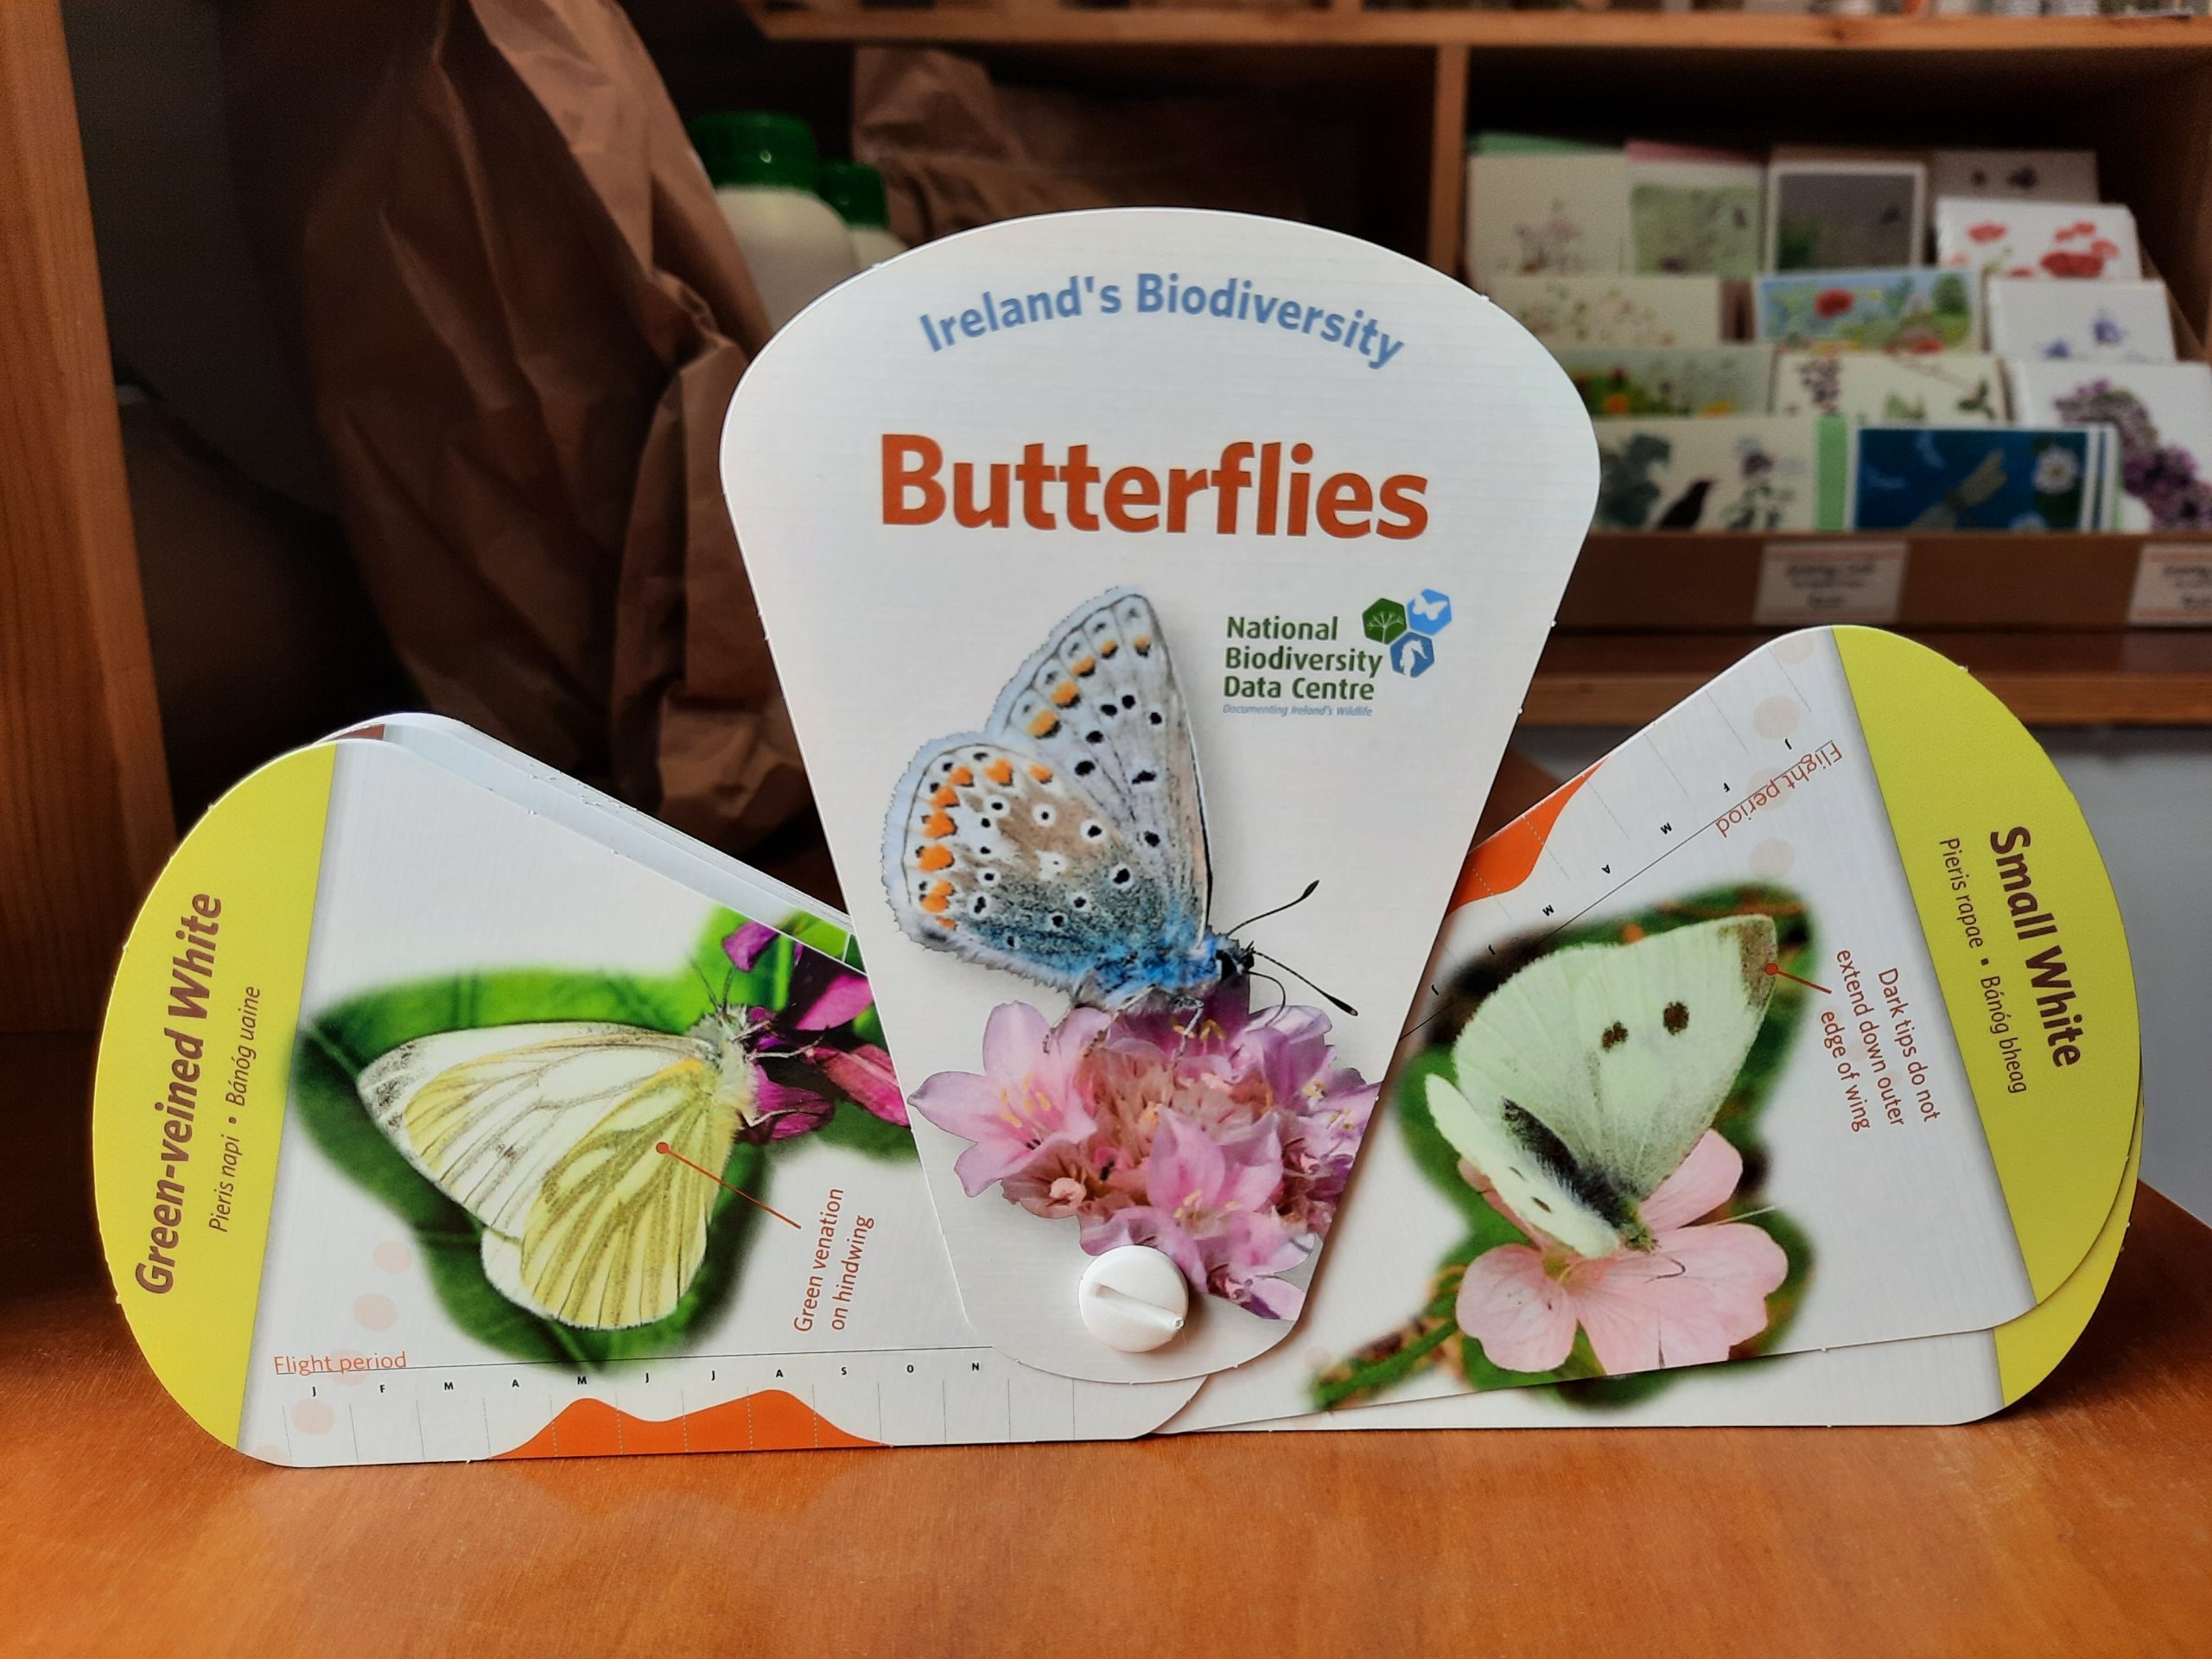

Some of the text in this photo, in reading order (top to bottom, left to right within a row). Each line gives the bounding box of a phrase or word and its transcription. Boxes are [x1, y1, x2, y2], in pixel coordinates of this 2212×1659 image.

[919, 272, 1404, 371] Ireland's Biodiversity
[880, 433, 1429, 540] Butterflies
[1224, 645, 1382, 678] Biodiversity
[1226, 615, 1338, 641] National
[1223, 704, 1373, 717] Documenting Ireland's Wildlife
[1224, 676, 1375, 701] Data Centre
[1715, 742, 1843, 838] Flight period
[1939, 836, 2027, 1095] Pieris rapae Bánóg bheag
[1990, 826, 2084, 1068] Small White
[135, 892, 223, 1294] Green-veined White
[1821, 1011, 1871, 1133] edge of wing
[1836, 949, 1905, 1125] extend down outer
[1878, 967, 1941, 1122] Dark tips do not
[208, 986, 261, 1234] Pieris napi Bánóg uaine
[793, 1187, 844, 1332] Green venation
[831, 1214, 874, 1331] on hindwing
[273, 1351, 408, 1376] Flight period
[312, 1362, 980, 1397] J F M A M J J A S O N
